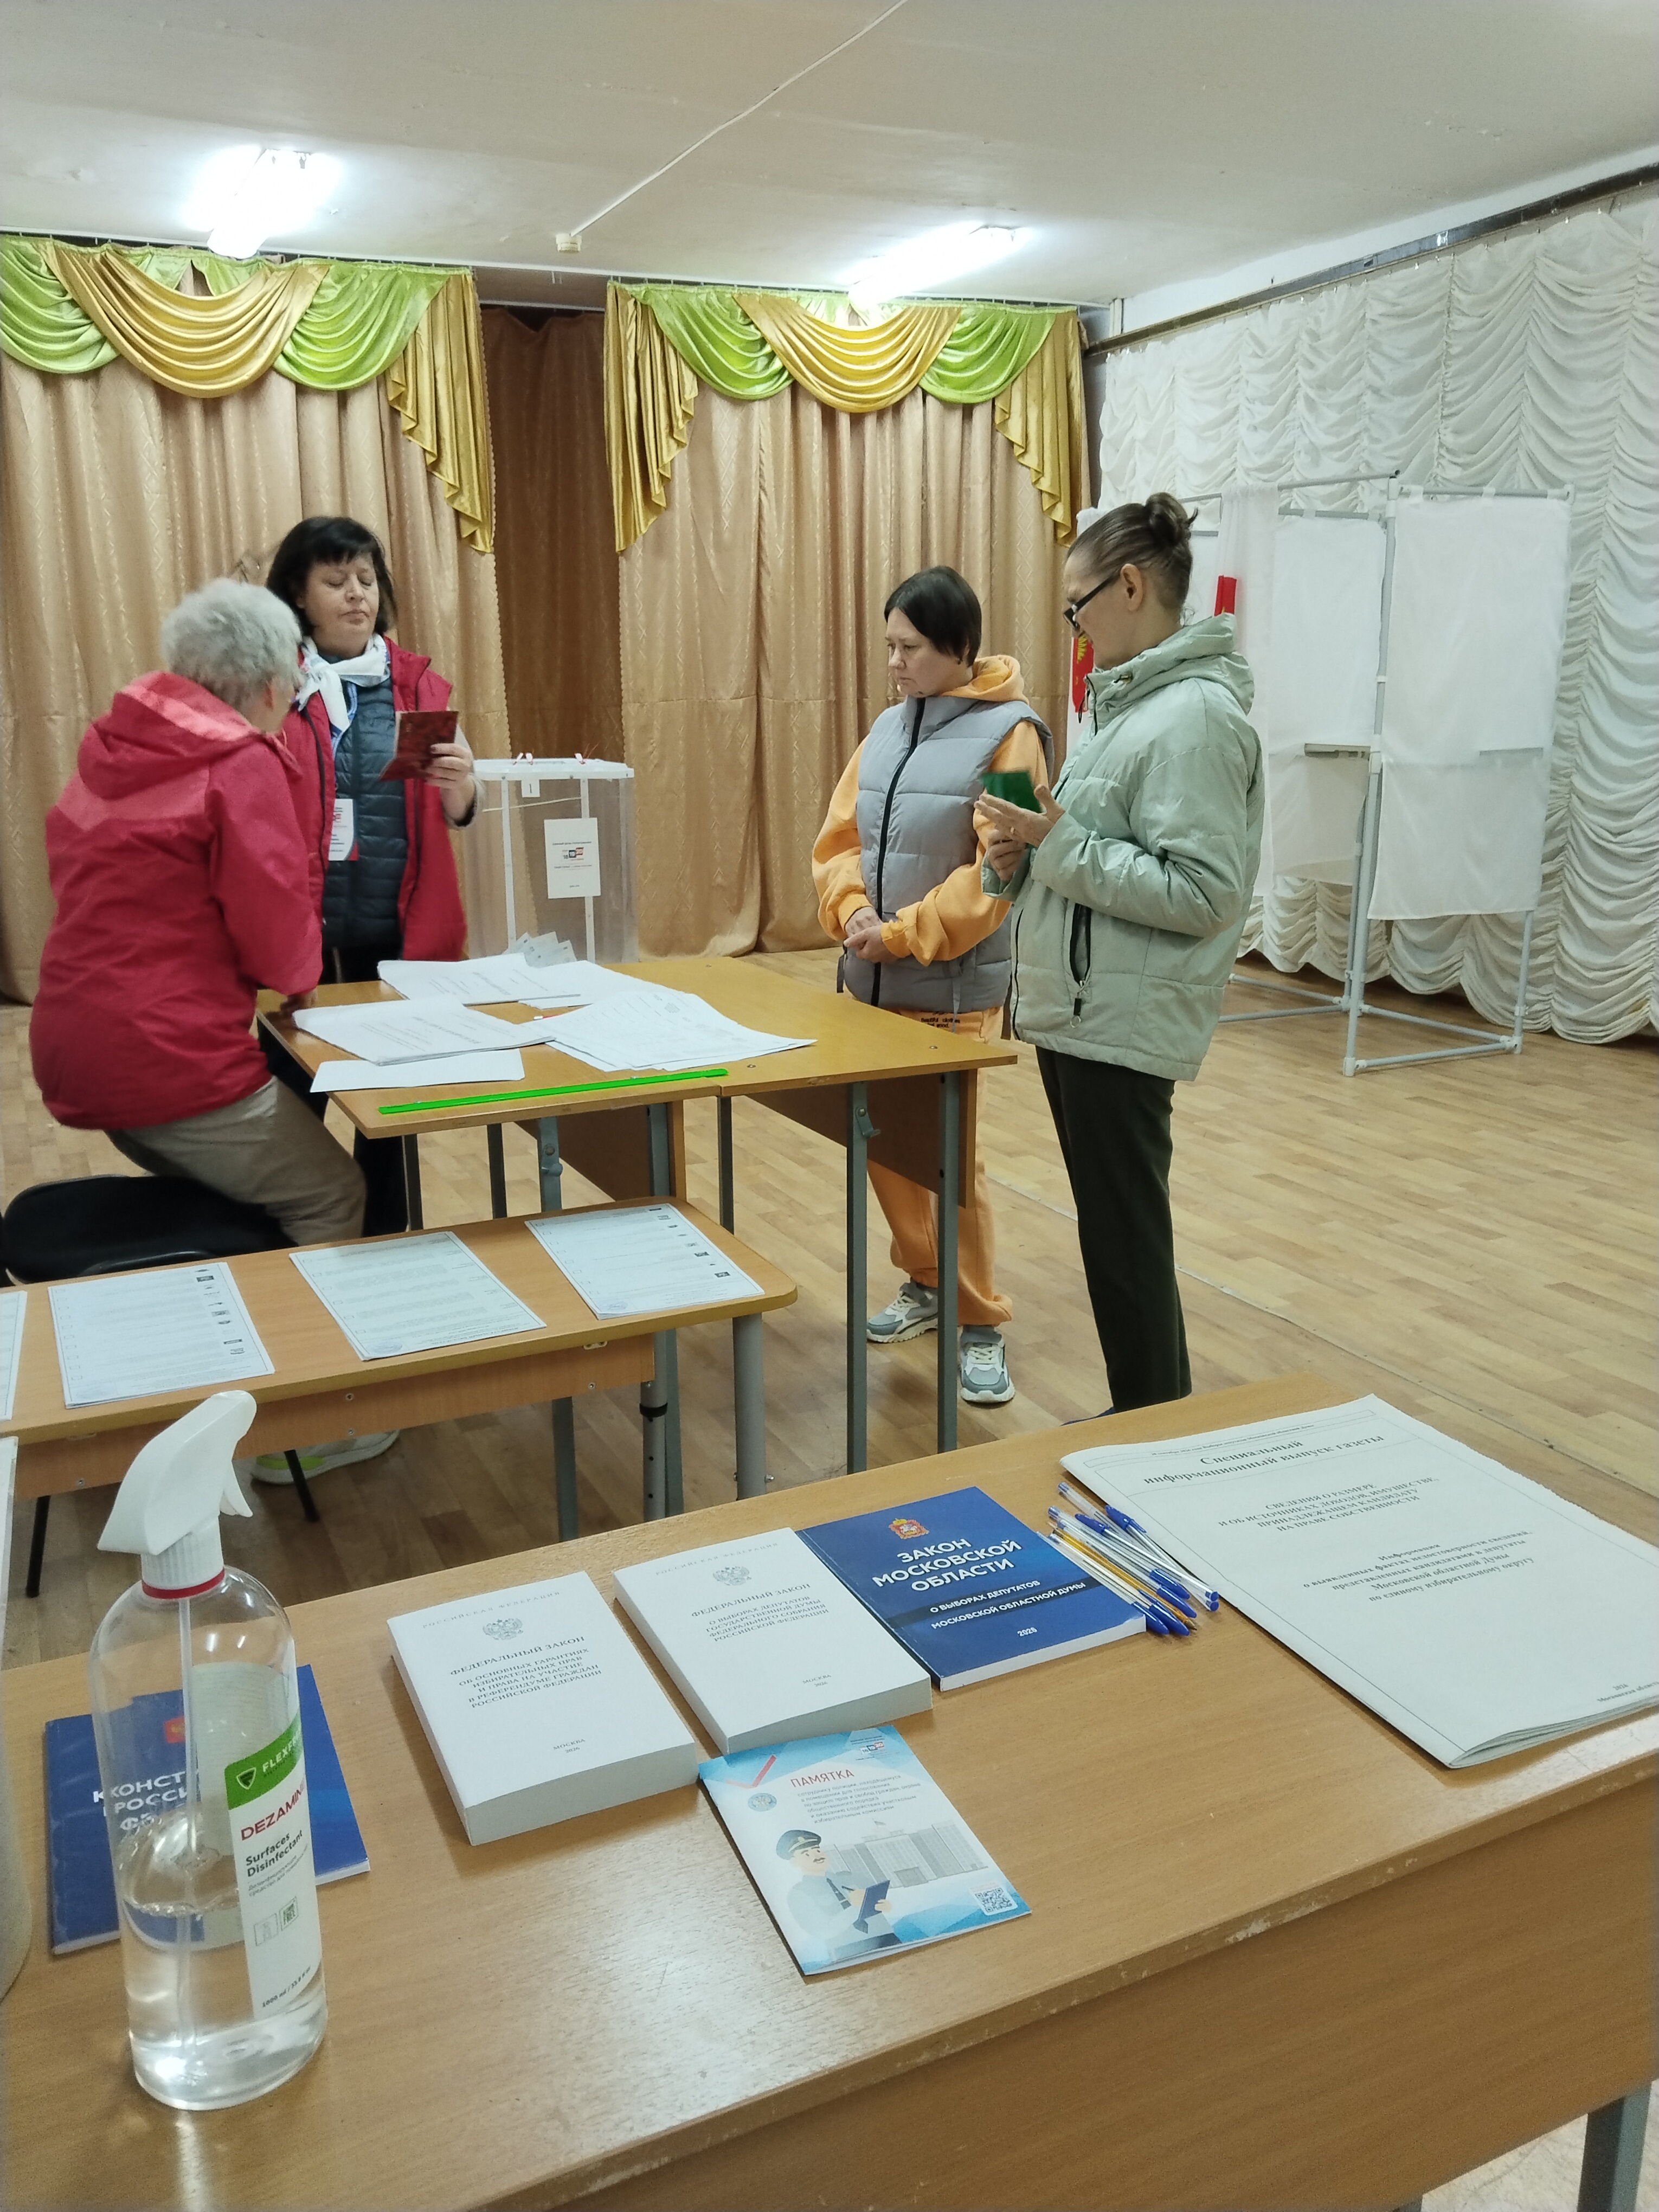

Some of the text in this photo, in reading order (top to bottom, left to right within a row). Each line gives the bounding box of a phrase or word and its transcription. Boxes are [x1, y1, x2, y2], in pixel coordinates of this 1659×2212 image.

[1144, 1436, 1385, 1484] информационный выпуск газеты
[1200, 1441, 1303, 1464] Специальный
[1245, 1503, 1319, 1521] ИСТОЧНИКАХ
[1369, 1477, 1439, 1496] ИМУЩЕСТВЕ,
[1257, 1488, 1418, 1527] ПРИНАДЛЕЖАЩЕМ КАНДИДАТУ
[1265, 1495, 1321, 1510] СВЕДЕНИЯ
[1332, 1483, 1377, 1497] РАЗМЕРЕ
[1294, 1517, 1329, 1527] ПРАВЕ
[1329, 1495, 1420, 1520] СОБСТВЕННОСТИ
[872, 1540, 1022, 1587] МОСКОВСКОЙ
[897, 1539, 972, 1562] ЗАКОН
[1311, 1568, 1374, 1586] выявленных
[1375, 1559, 1411, 1571] фактах
[1411, 1541, 1487, 1561] недостоверности
[1332, 1567, 1412, 1590] представленных
[1412, 1552, 1474, 1571] кандидатами
[1482, 1540, 1526, 1553] депутаты
[1378, 1544, 1441, 1561] Информация
[911, 1559, 1014, 1591] ОБЛАСТИ
[1371, 1553, 1510, 1590] Московской областной Думы
[1383, 1585, 1424, 1598] единому
[1425, 1565, 1501, 1589] избирательному
[1502, 1557, 1534, 1568] округу
[691, 1583, 811, 1617] ФЕДЕРАЛЬНЫЙ ЗАКОН
[718, 1608, 759, 1623] ВЫБОРАХ
[761, 1596, 811, 1611] ДЕПУТАТОВ
[931, 1582, 1085, 1629] МОСКОВСКОЙ ОБЛАСТНОЙ ДУМЫ
[939, 1594, 987, 1611] ВЫБОРАХ
[987, 1580, 1040, 1599] ДЕПУТАТОВ
[422, 1607, 493, 1628] РОССИЙСКАЯ
[705, 1599, 821, 1632] ГОСУДАРСТВЕННОЙ ДУМЫ
[709, 1604, 826, 1637] ФЕДЕРАЛЬНОГО СОБРАНИЯ
[714, 1609, 829, 1642] РОССИЙСКОЙ ФЕДЕРАЦИИ
[1017, 1627, 1037, 1636] 2026
[451, 1636, 585, 1676] ФЕДЕРАЛЬНЫЙ ЗАКОН
[473, 1656, 582, 1688] ИЗБИРАТЕЛЬНЫХ ПРАВ
[475, 1662, 532, 1680] ОСНОВНЫХ
[534, 1648, 589, 1665] ГАРАНТИЯХ
[472, 1670, 602, 1708] РОССИЙСКОЙ ФЕДЕРАЦИИ
[478, 1676, 551, 1700] РЕФЕРЕНДУМЕ
[554, 1664, 599, 1679] ГРАЖДАН
[488, 1678, 519, 1690] ПРАВА
[539, 1662, 583, 1676] УЧАСТИЕ
[553, 1739, 585, 1750] МОСКВА
[790, 1769, 855, 1787] ПАМЯТКА
[798, 1787, 831, 1797] сотруднику
[805, 1792, 840, 1801] помещении
[853, 1783, 890, 1792] голосования
[241, 1778, 305, 1841] DEZAMIN
[807, 1797, 879, 1814] общественного порядка
[815, 1808, 846, 1817] оказанию
[846, 1802, 881, 1812] содействия
[882, 1795, 917, 1805] участковым
[854, 1791, 875, 1799] свобод
[814, 1805, 895, 1824] избирательным комиссиям
[246, 1833, 290, 1866] Surfaces
[247, 1830, 303, 1877] Disinfectant
[262, 1995, 278, 2008] 1000
